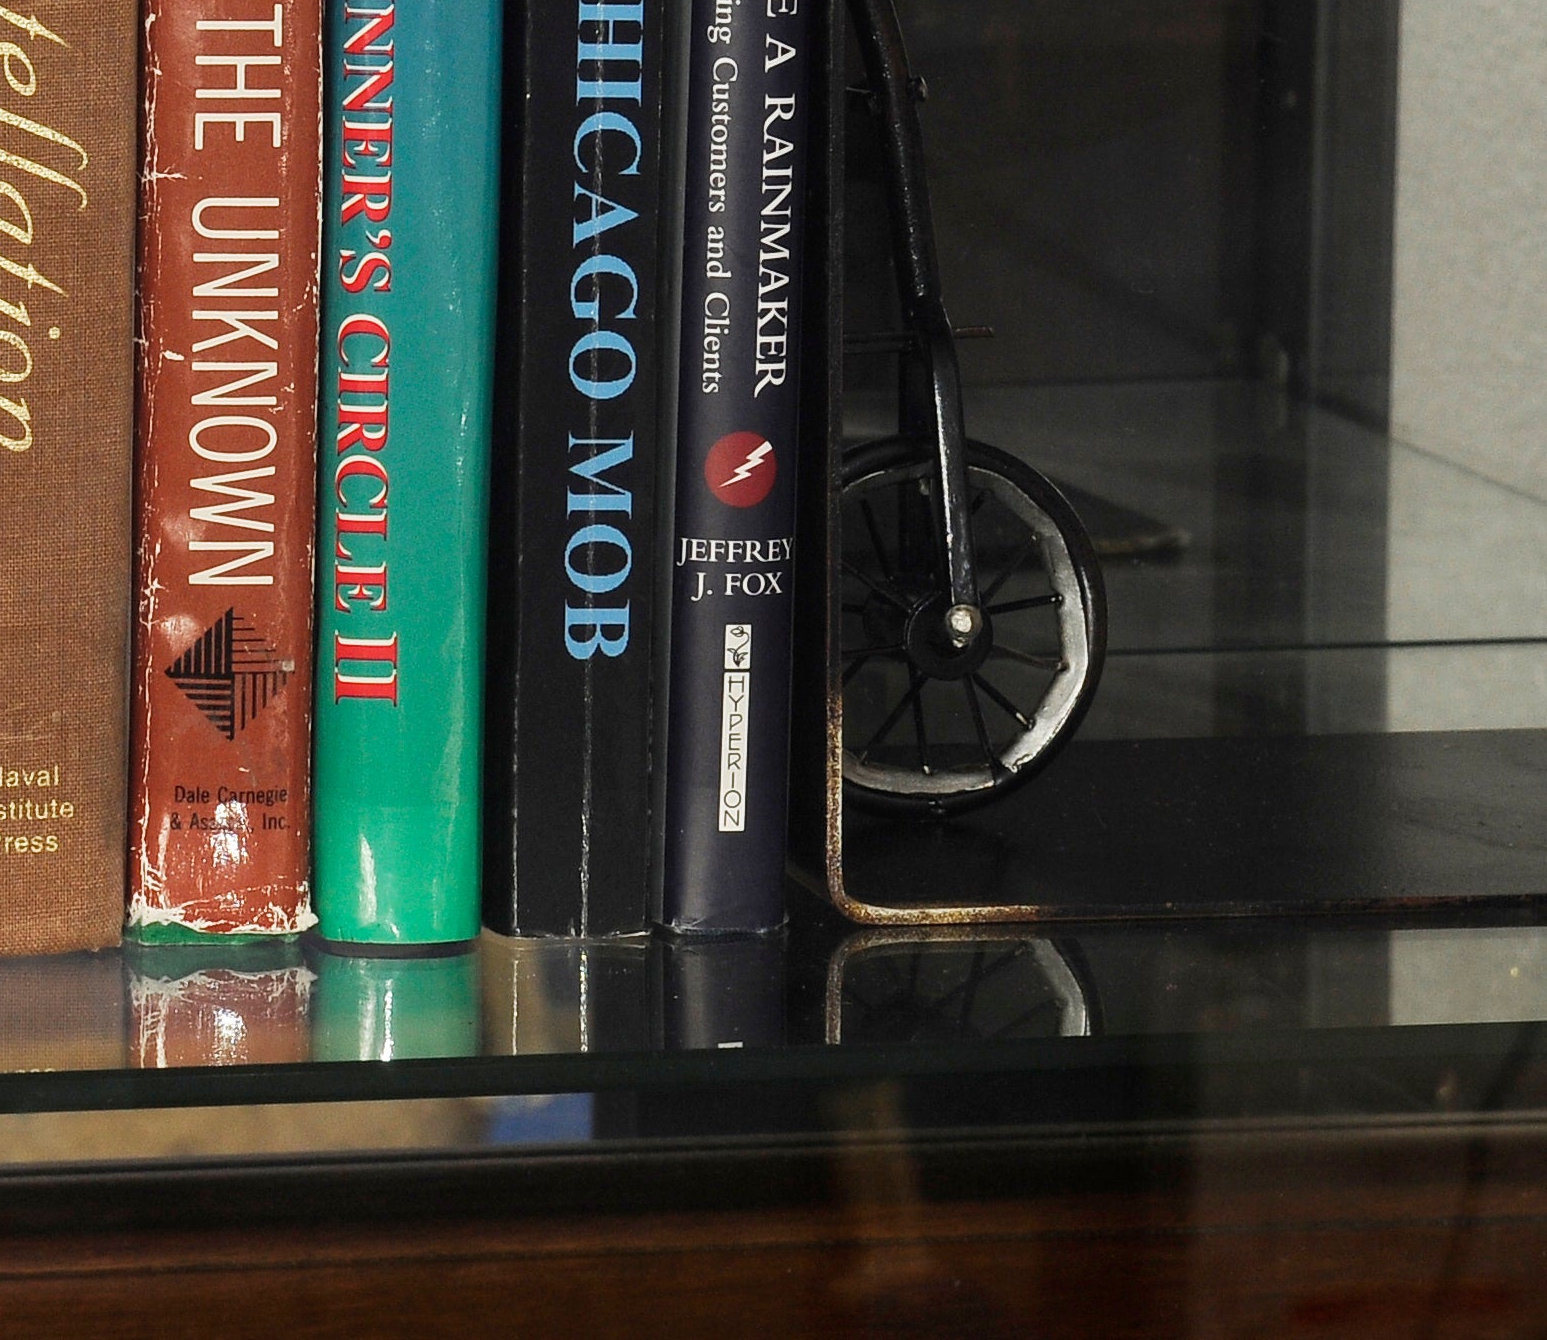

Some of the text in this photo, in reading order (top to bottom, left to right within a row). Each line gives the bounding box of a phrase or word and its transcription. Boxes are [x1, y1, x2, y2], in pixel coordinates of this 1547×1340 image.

[194, 3, 282, 152] THE
[764, 33, 797, 73] A
[708, 57, 739, 214] Customers
[705, 223, 734, 279] and
[753, 92, 797, 399] RAINMAKER
[188, 197, 279, 586] UNKNOWN
[701, 291, 731, 395] Clients
[335, 312, 392, 614] CIRCLE
[563, 429, 635, 662] MOB
[676, 536, 793, 567] JEFFREY
[691, 572, 783, 602] J. FOX
[334, 629, 399, 707] II
[175, 785, 287, 807] Dale Carnegie
[722, 675, 745, 827] HYPERION
[170, 812, 181, 830] &
[263, 813, 291, 830] Inc.
